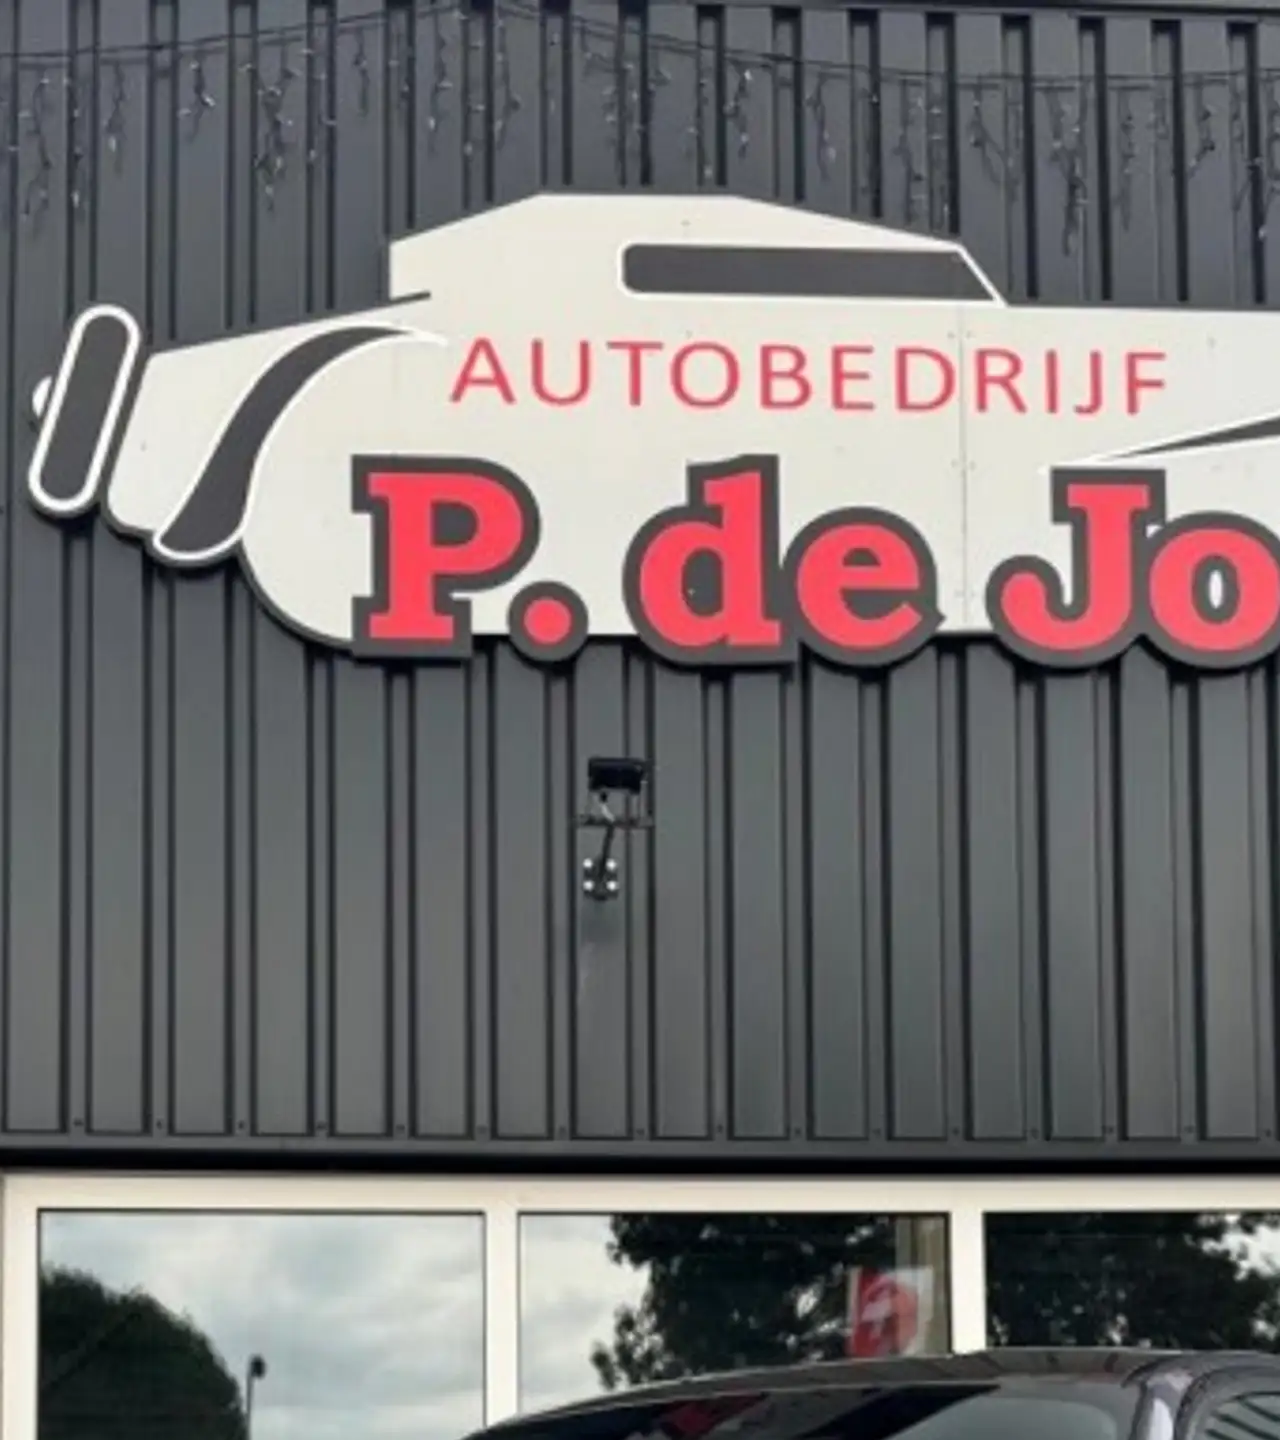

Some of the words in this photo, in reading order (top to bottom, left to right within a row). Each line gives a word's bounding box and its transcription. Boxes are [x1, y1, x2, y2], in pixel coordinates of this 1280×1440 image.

[451, 336, 1164, 416] AUTOBEDRIJF
[363, 467, 577, 648] P.
[636, 467, 923, 654] de
